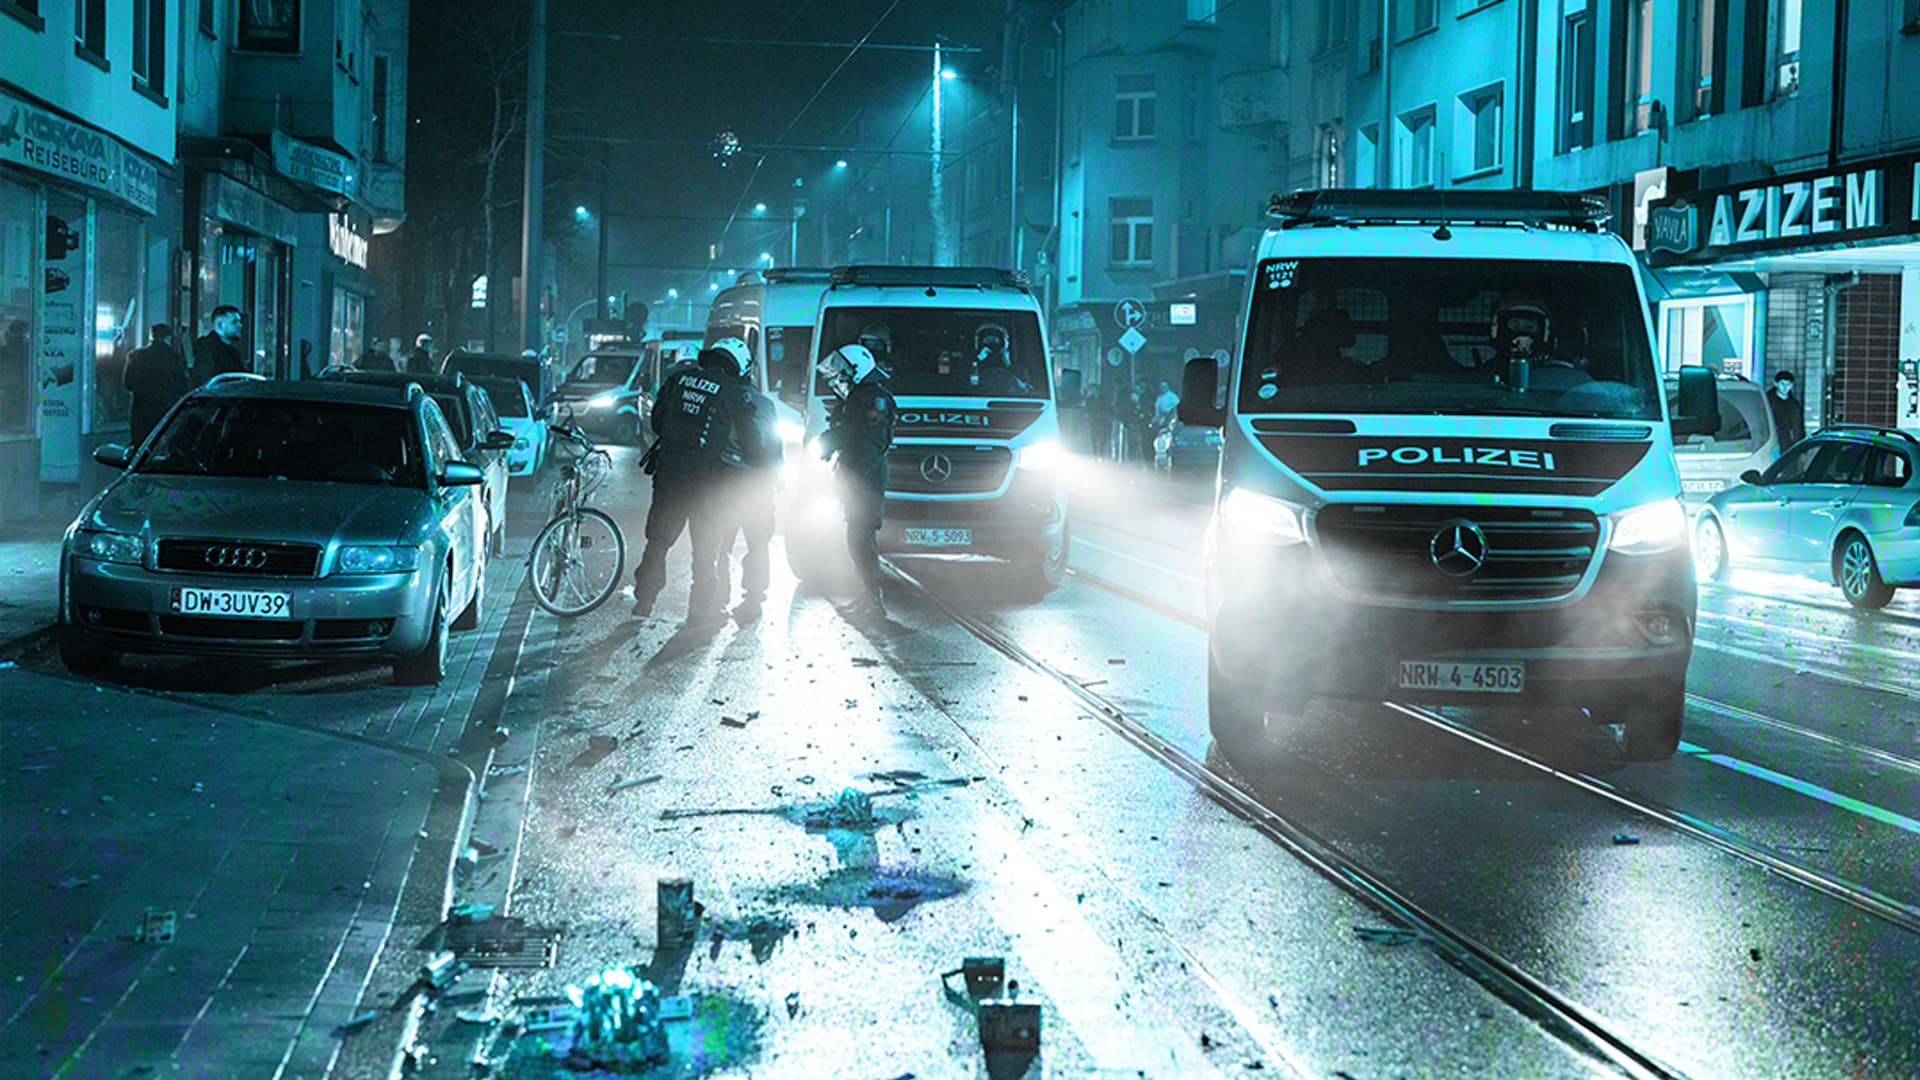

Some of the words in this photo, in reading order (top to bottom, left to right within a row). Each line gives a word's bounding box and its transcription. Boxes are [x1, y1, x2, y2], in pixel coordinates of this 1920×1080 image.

[24, 137, 108, 184] REISEBÜRO
[1708, 169, 1878, 246] AZIZEM
[679, 375, 720, 395] POLIZEI
[894, 413, 989, 426] OLIZEI
[1358, 446, 1555, 471] POLIZEI
[1401, 664, 1438, 685] NRW
[1450, 665, 1521, 689] 4-4503
